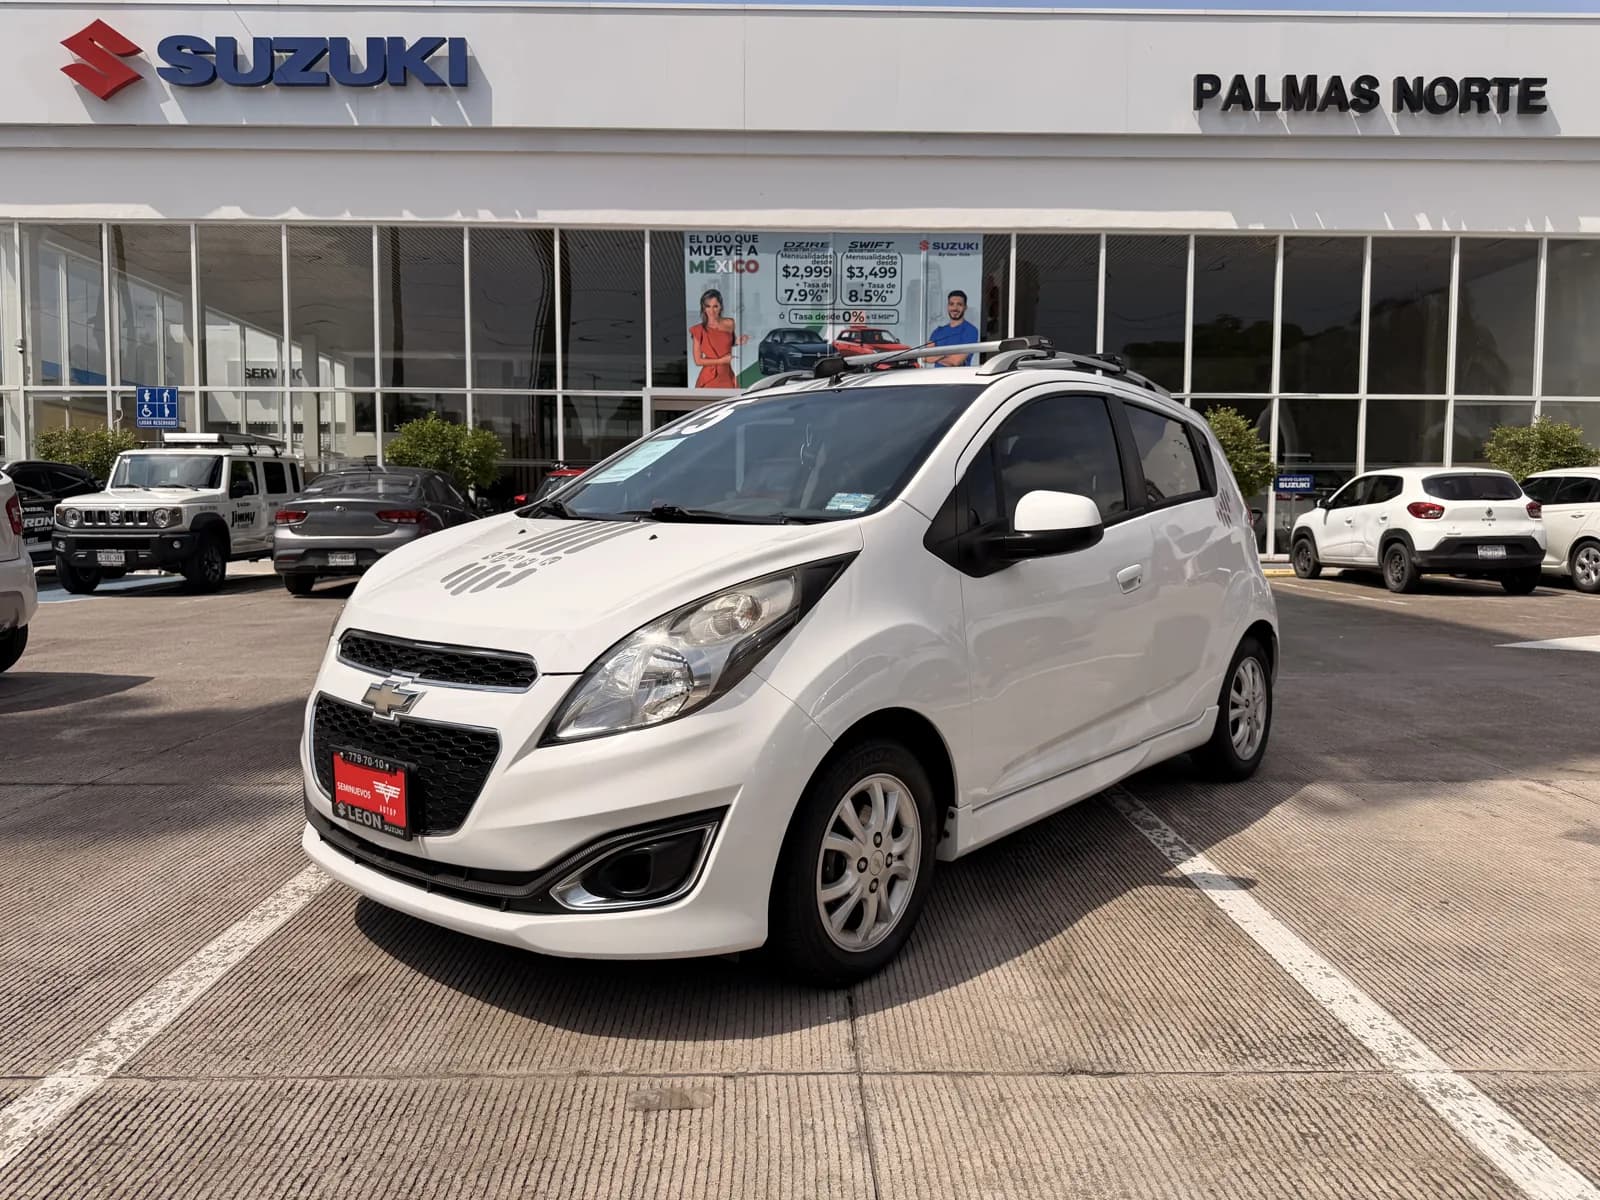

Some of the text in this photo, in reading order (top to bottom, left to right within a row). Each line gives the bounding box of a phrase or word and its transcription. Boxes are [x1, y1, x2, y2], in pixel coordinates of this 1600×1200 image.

[156, 35, 469, 88] SUZUKI
[1193, 74, 1548, 114] PALMAS NORTE
[689, 234, 703, 243] EL
[735, 234, 759, 244] QUE
[848, 241, 895, 249] SWIFT
[932, 241, 979, 250] SUZUKI
[689, 245, 758, 256] MUEVE A
[689, 257, 760, 274] MÉXICO
[782, 264, 832, 279] $2,999
[846, 265, 897, 280] $3,499
[794, 312, 813, 320] Tasa
[815, 312, 840, 320] desde
[842, 310, 865, 322] 0%
[337, 782, 371, 799] SEMINUEVOS
[347, 805, 382, 829] LEON
